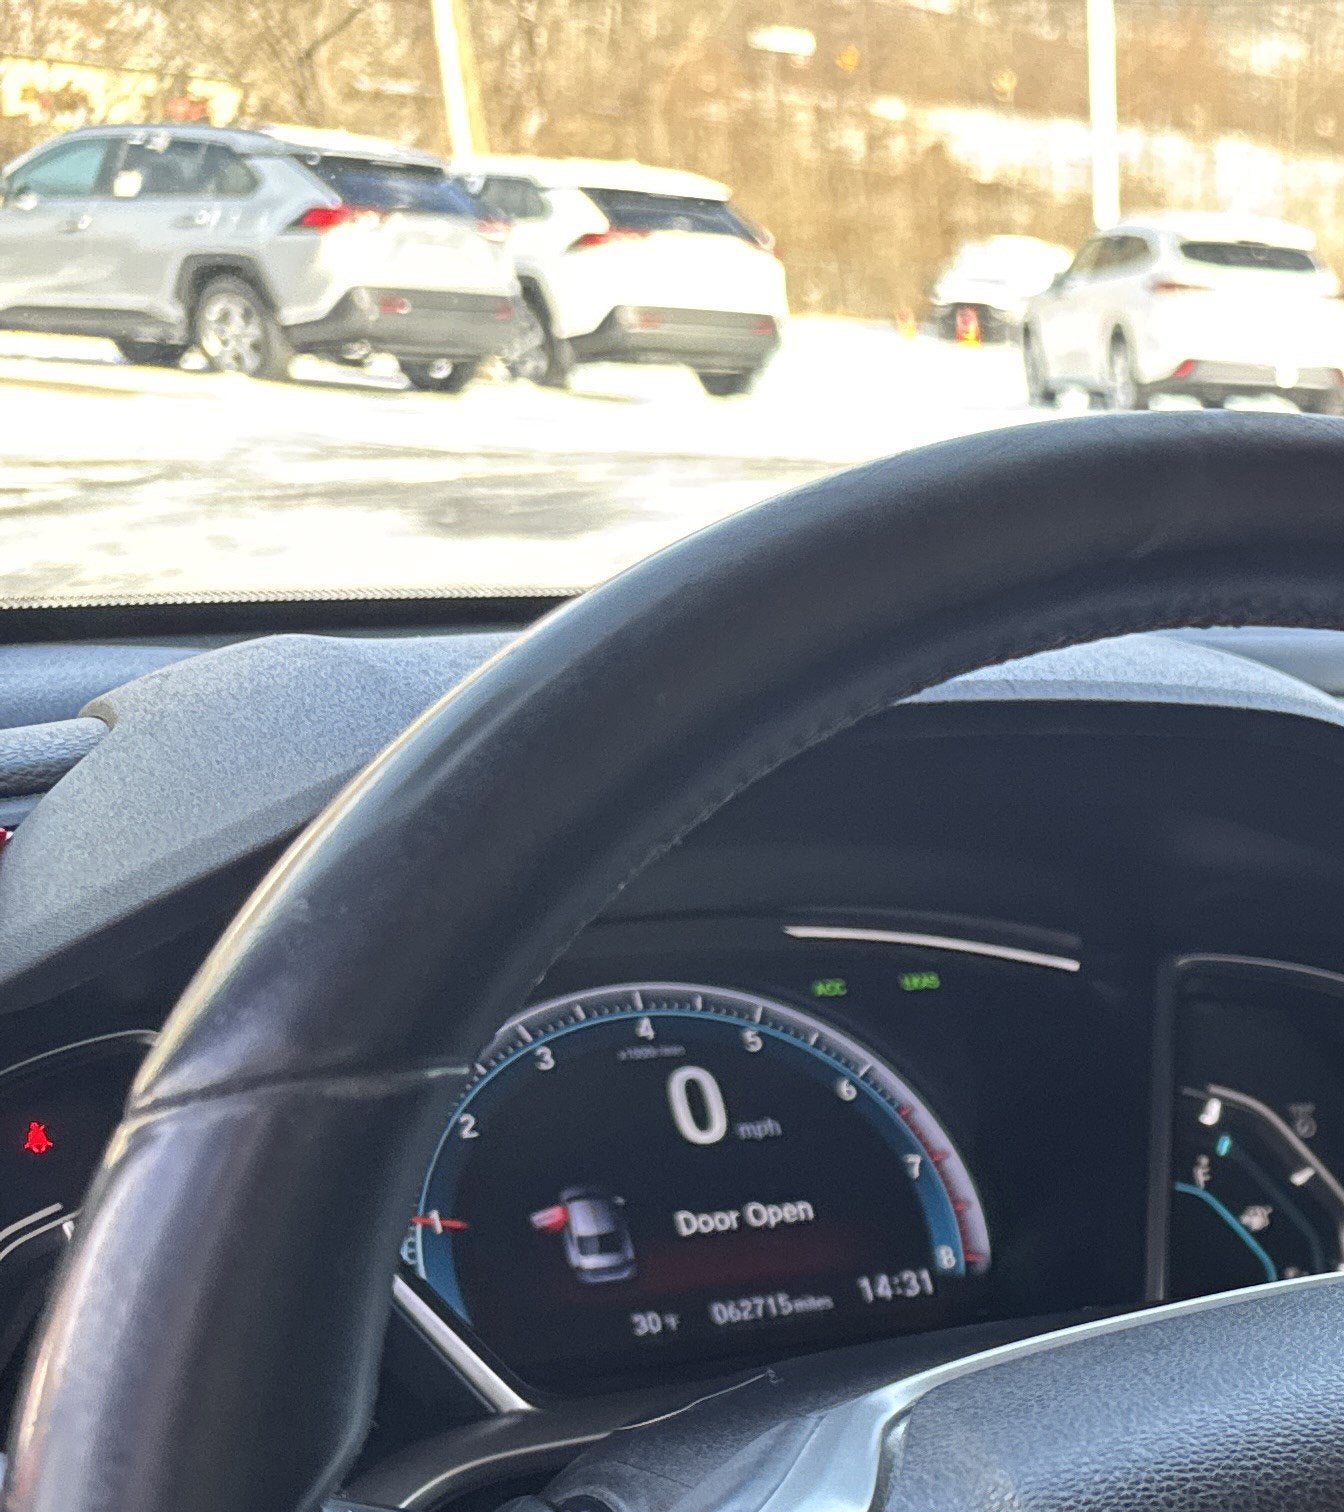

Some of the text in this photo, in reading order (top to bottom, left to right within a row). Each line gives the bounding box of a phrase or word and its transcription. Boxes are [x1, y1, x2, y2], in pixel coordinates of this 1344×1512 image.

[636, 1017, 655, 1040] 4
[743, 1030, 762, 1052] 5
[535, 1048, 556, 1071] 3
[837, 1078, 858, 1101] 6
[667, 1065, 728, 1145] 0
[459, 1113, 482, 1139] 2
[905, 1154, 922, 1178] 7
[674, 1200, 815, 1237] Door Open
[936, 1245, 958, 1269] 8
[856, 1267, 934, 1303] 14:31
